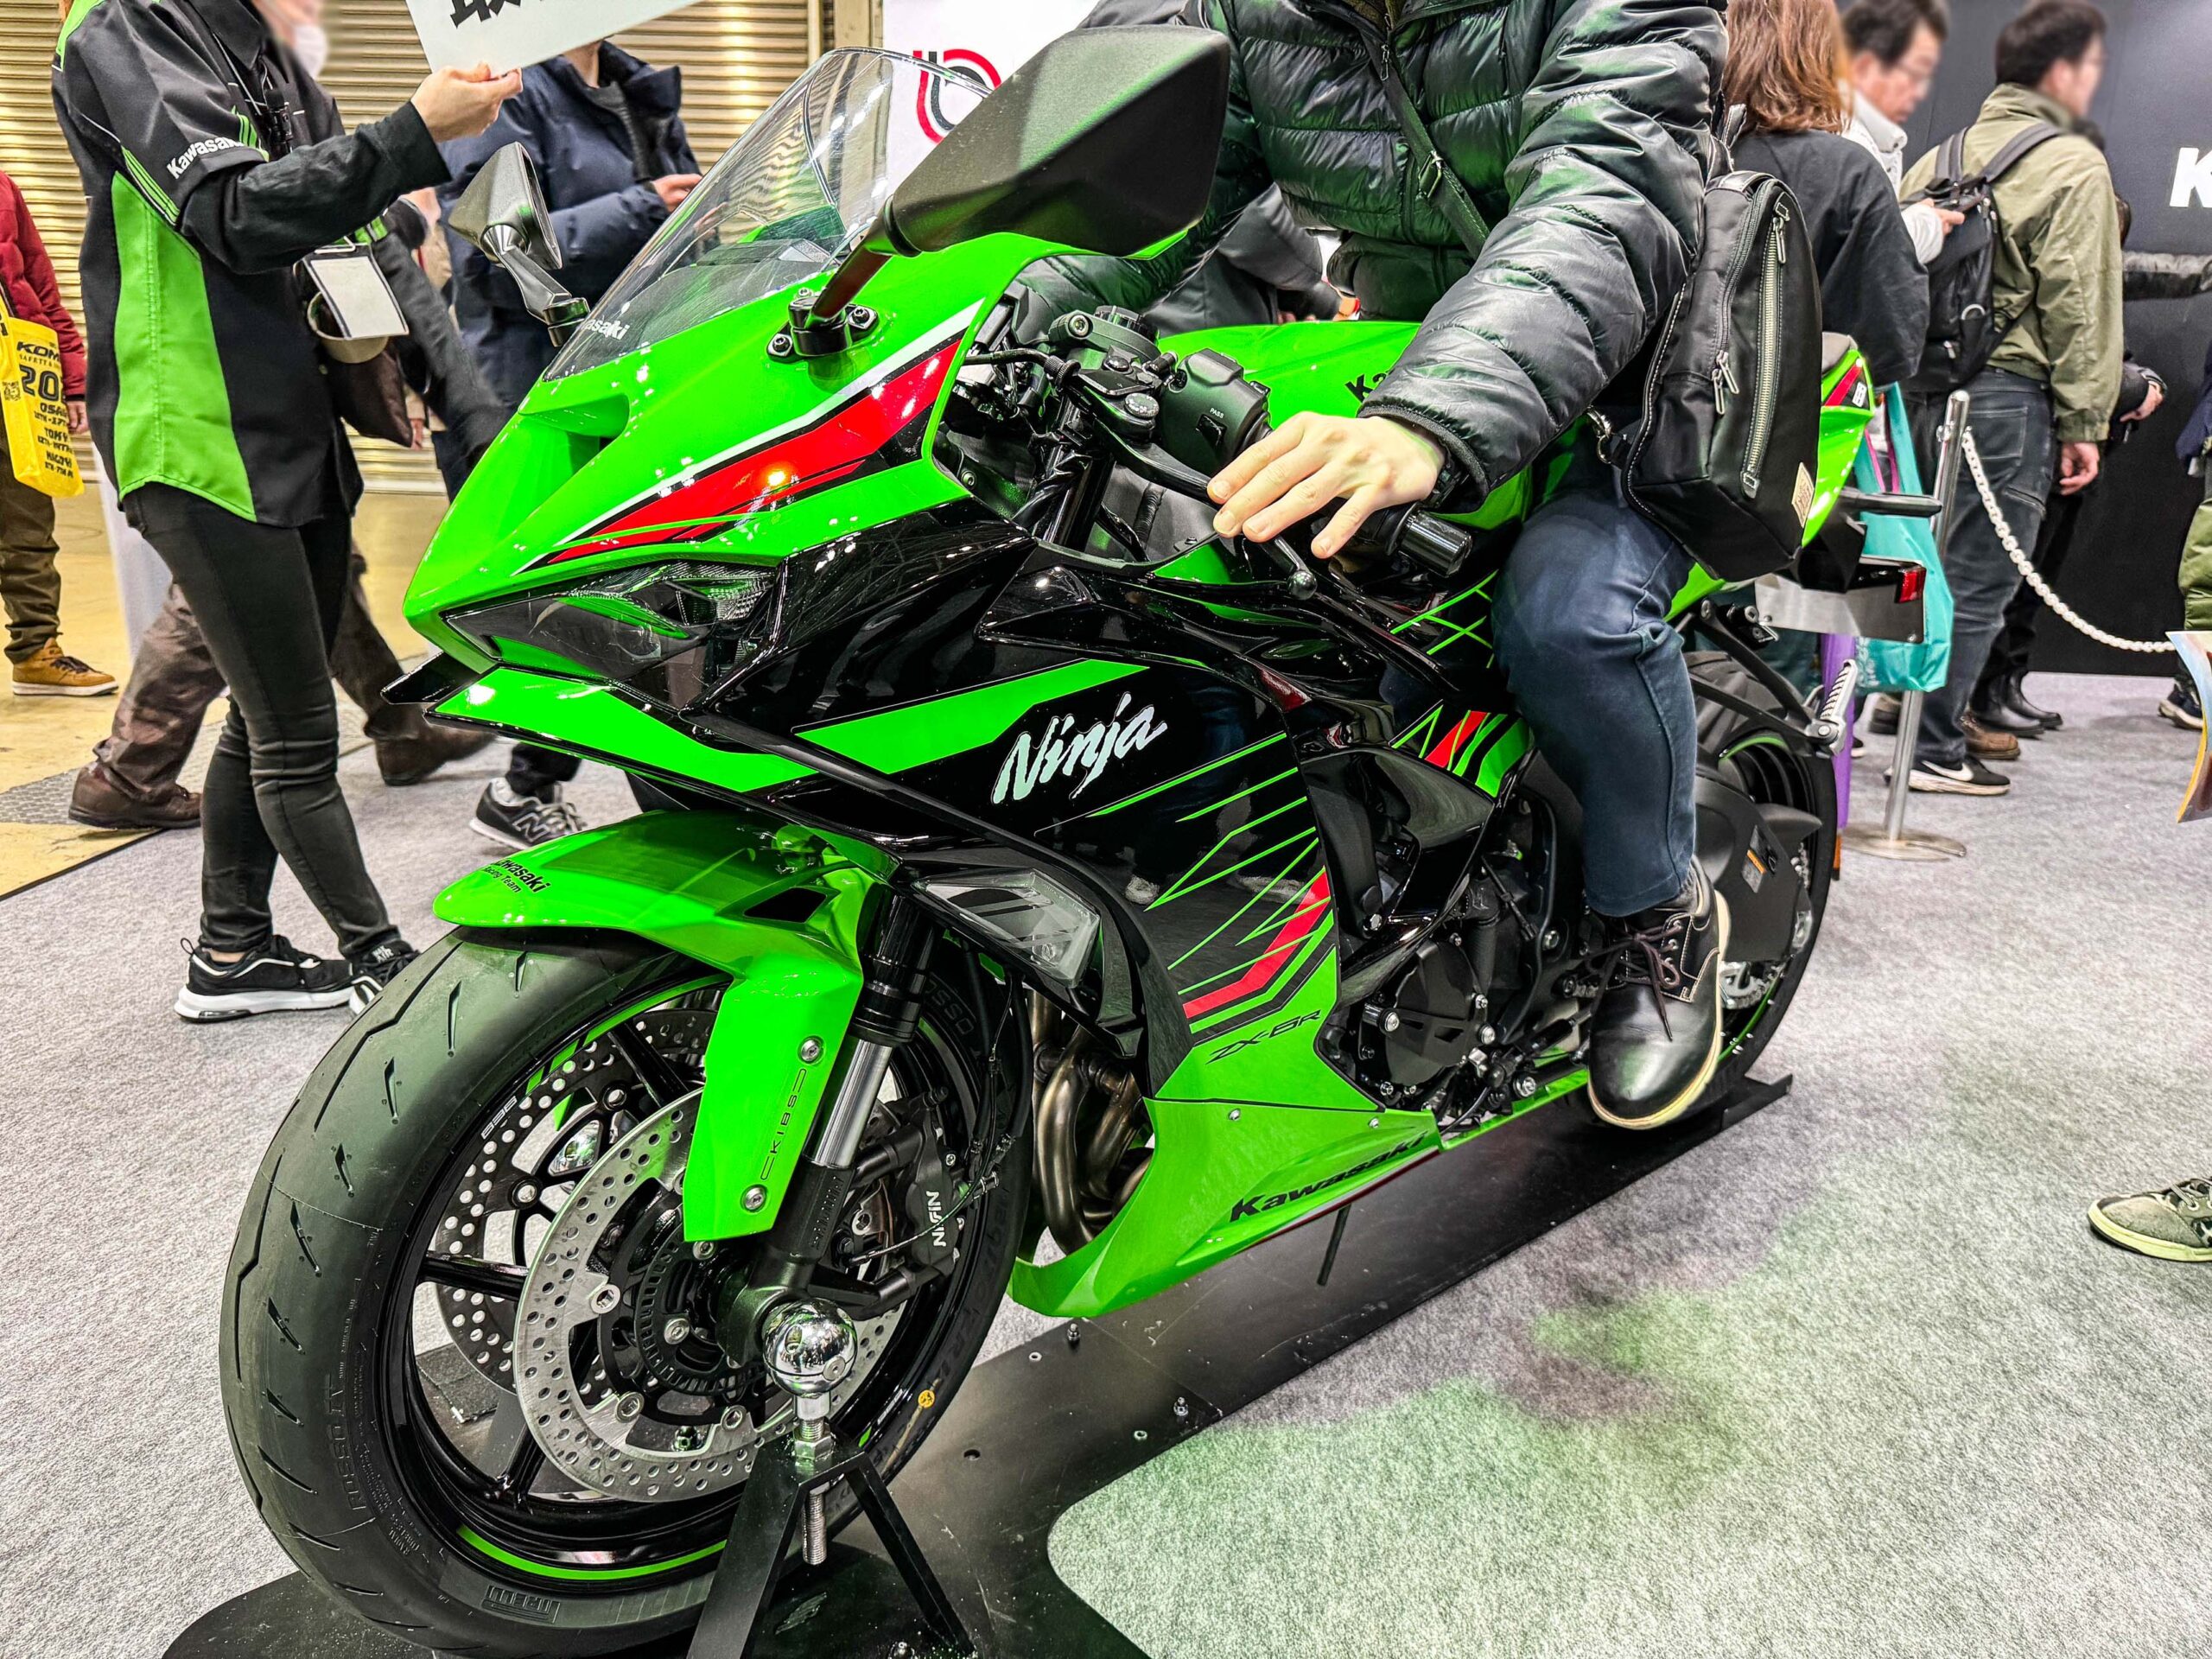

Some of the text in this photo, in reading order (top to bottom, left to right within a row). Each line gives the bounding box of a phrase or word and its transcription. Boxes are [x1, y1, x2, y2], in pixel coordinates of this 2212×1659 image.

[586, 319, 630, 340] asaki
[16, 341, 60, 361] KOM
[19, 364, 66, 403] 20
[1210, 407, 1224, 419] PASS
[991, 691, 1167, 804] Ninja
[491, 860, 550, 893] wasaki
[500, 875, 522, 893] Team
[1205, 1009, 1322, 1065] ZX-6R
[770, 1094, 798, 1154] KIBS
[1230, 1130, 1428, 1223] Kawasaki
